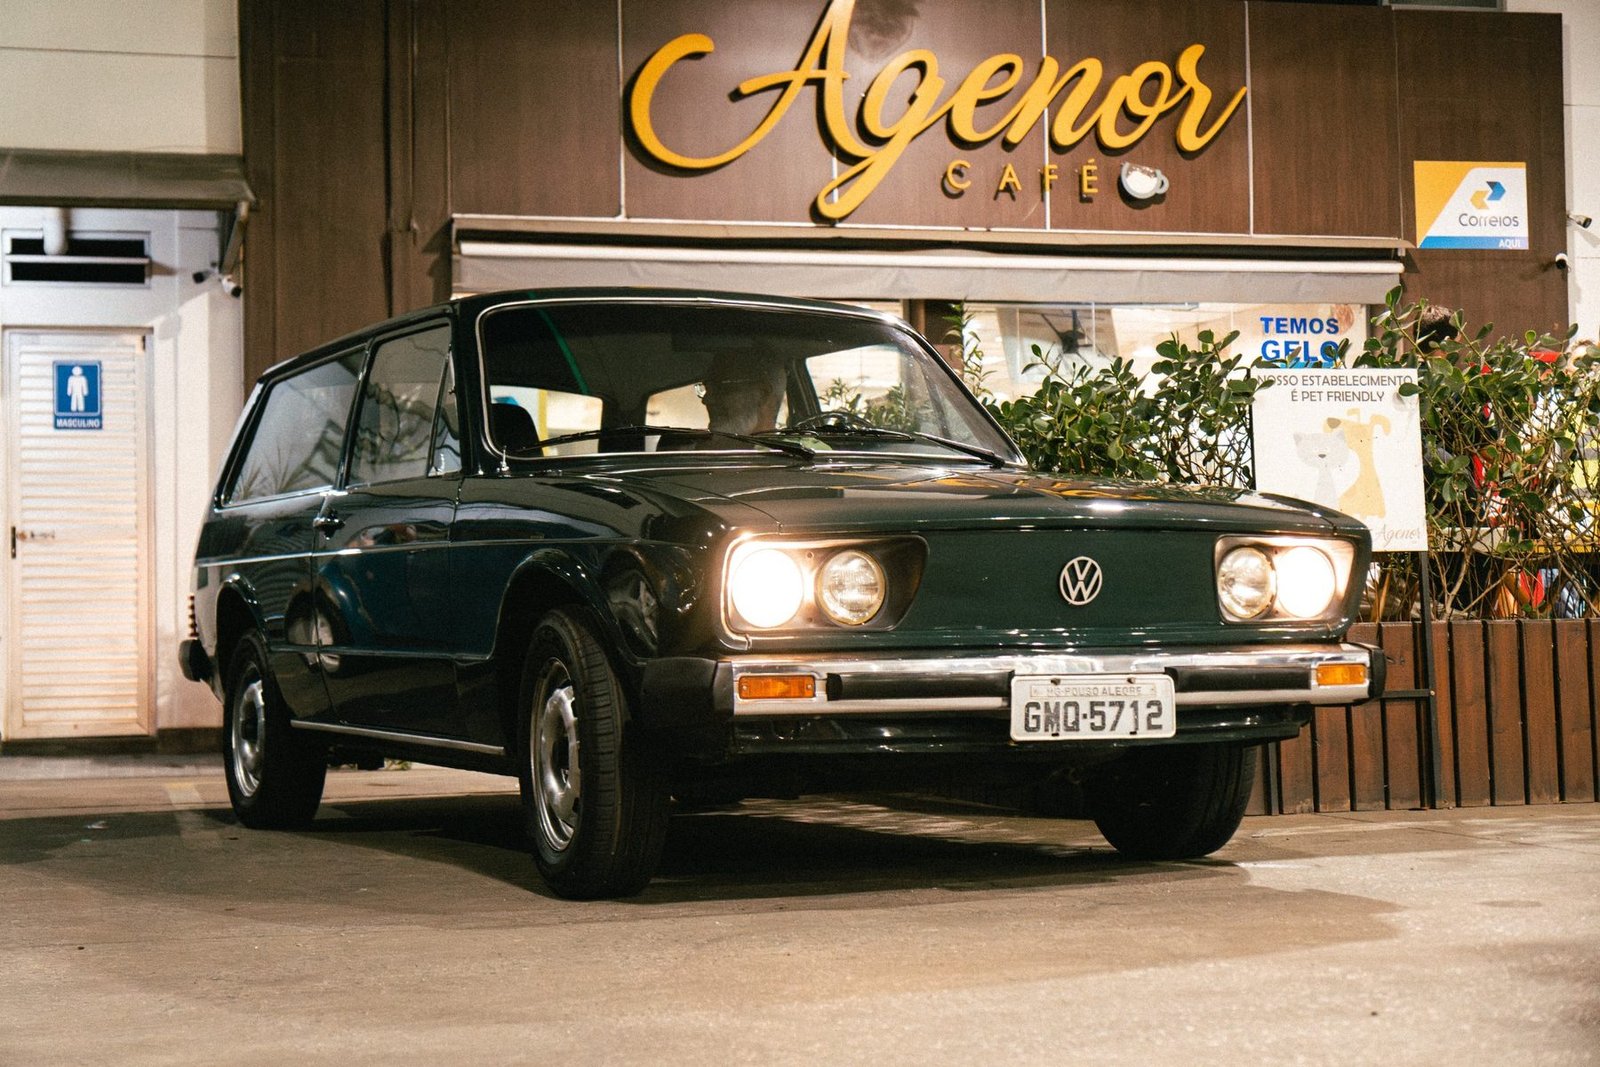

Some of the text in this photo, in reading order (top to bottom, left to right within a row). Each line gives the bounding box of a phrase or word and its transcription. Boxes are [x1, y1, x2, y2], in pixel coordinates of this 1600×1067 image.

[630, 0, 1248, 219] Agenor
[945, 158, 1100, 195] CAFÉ
[1458, 213, 1520, 227] Correios
[1498, 239, 1521, 248] AQUI
[1260, 317, 1340, 335] TEMOS
[1261, 340, 1340, 362] GELO
[1257, 374, 1413, 387] NOSSO ESTABELECIMENTO
[1291, 388, 1385, 402] É PET FRIENDLY
[56, 418, 100, 428] MASCULINO
